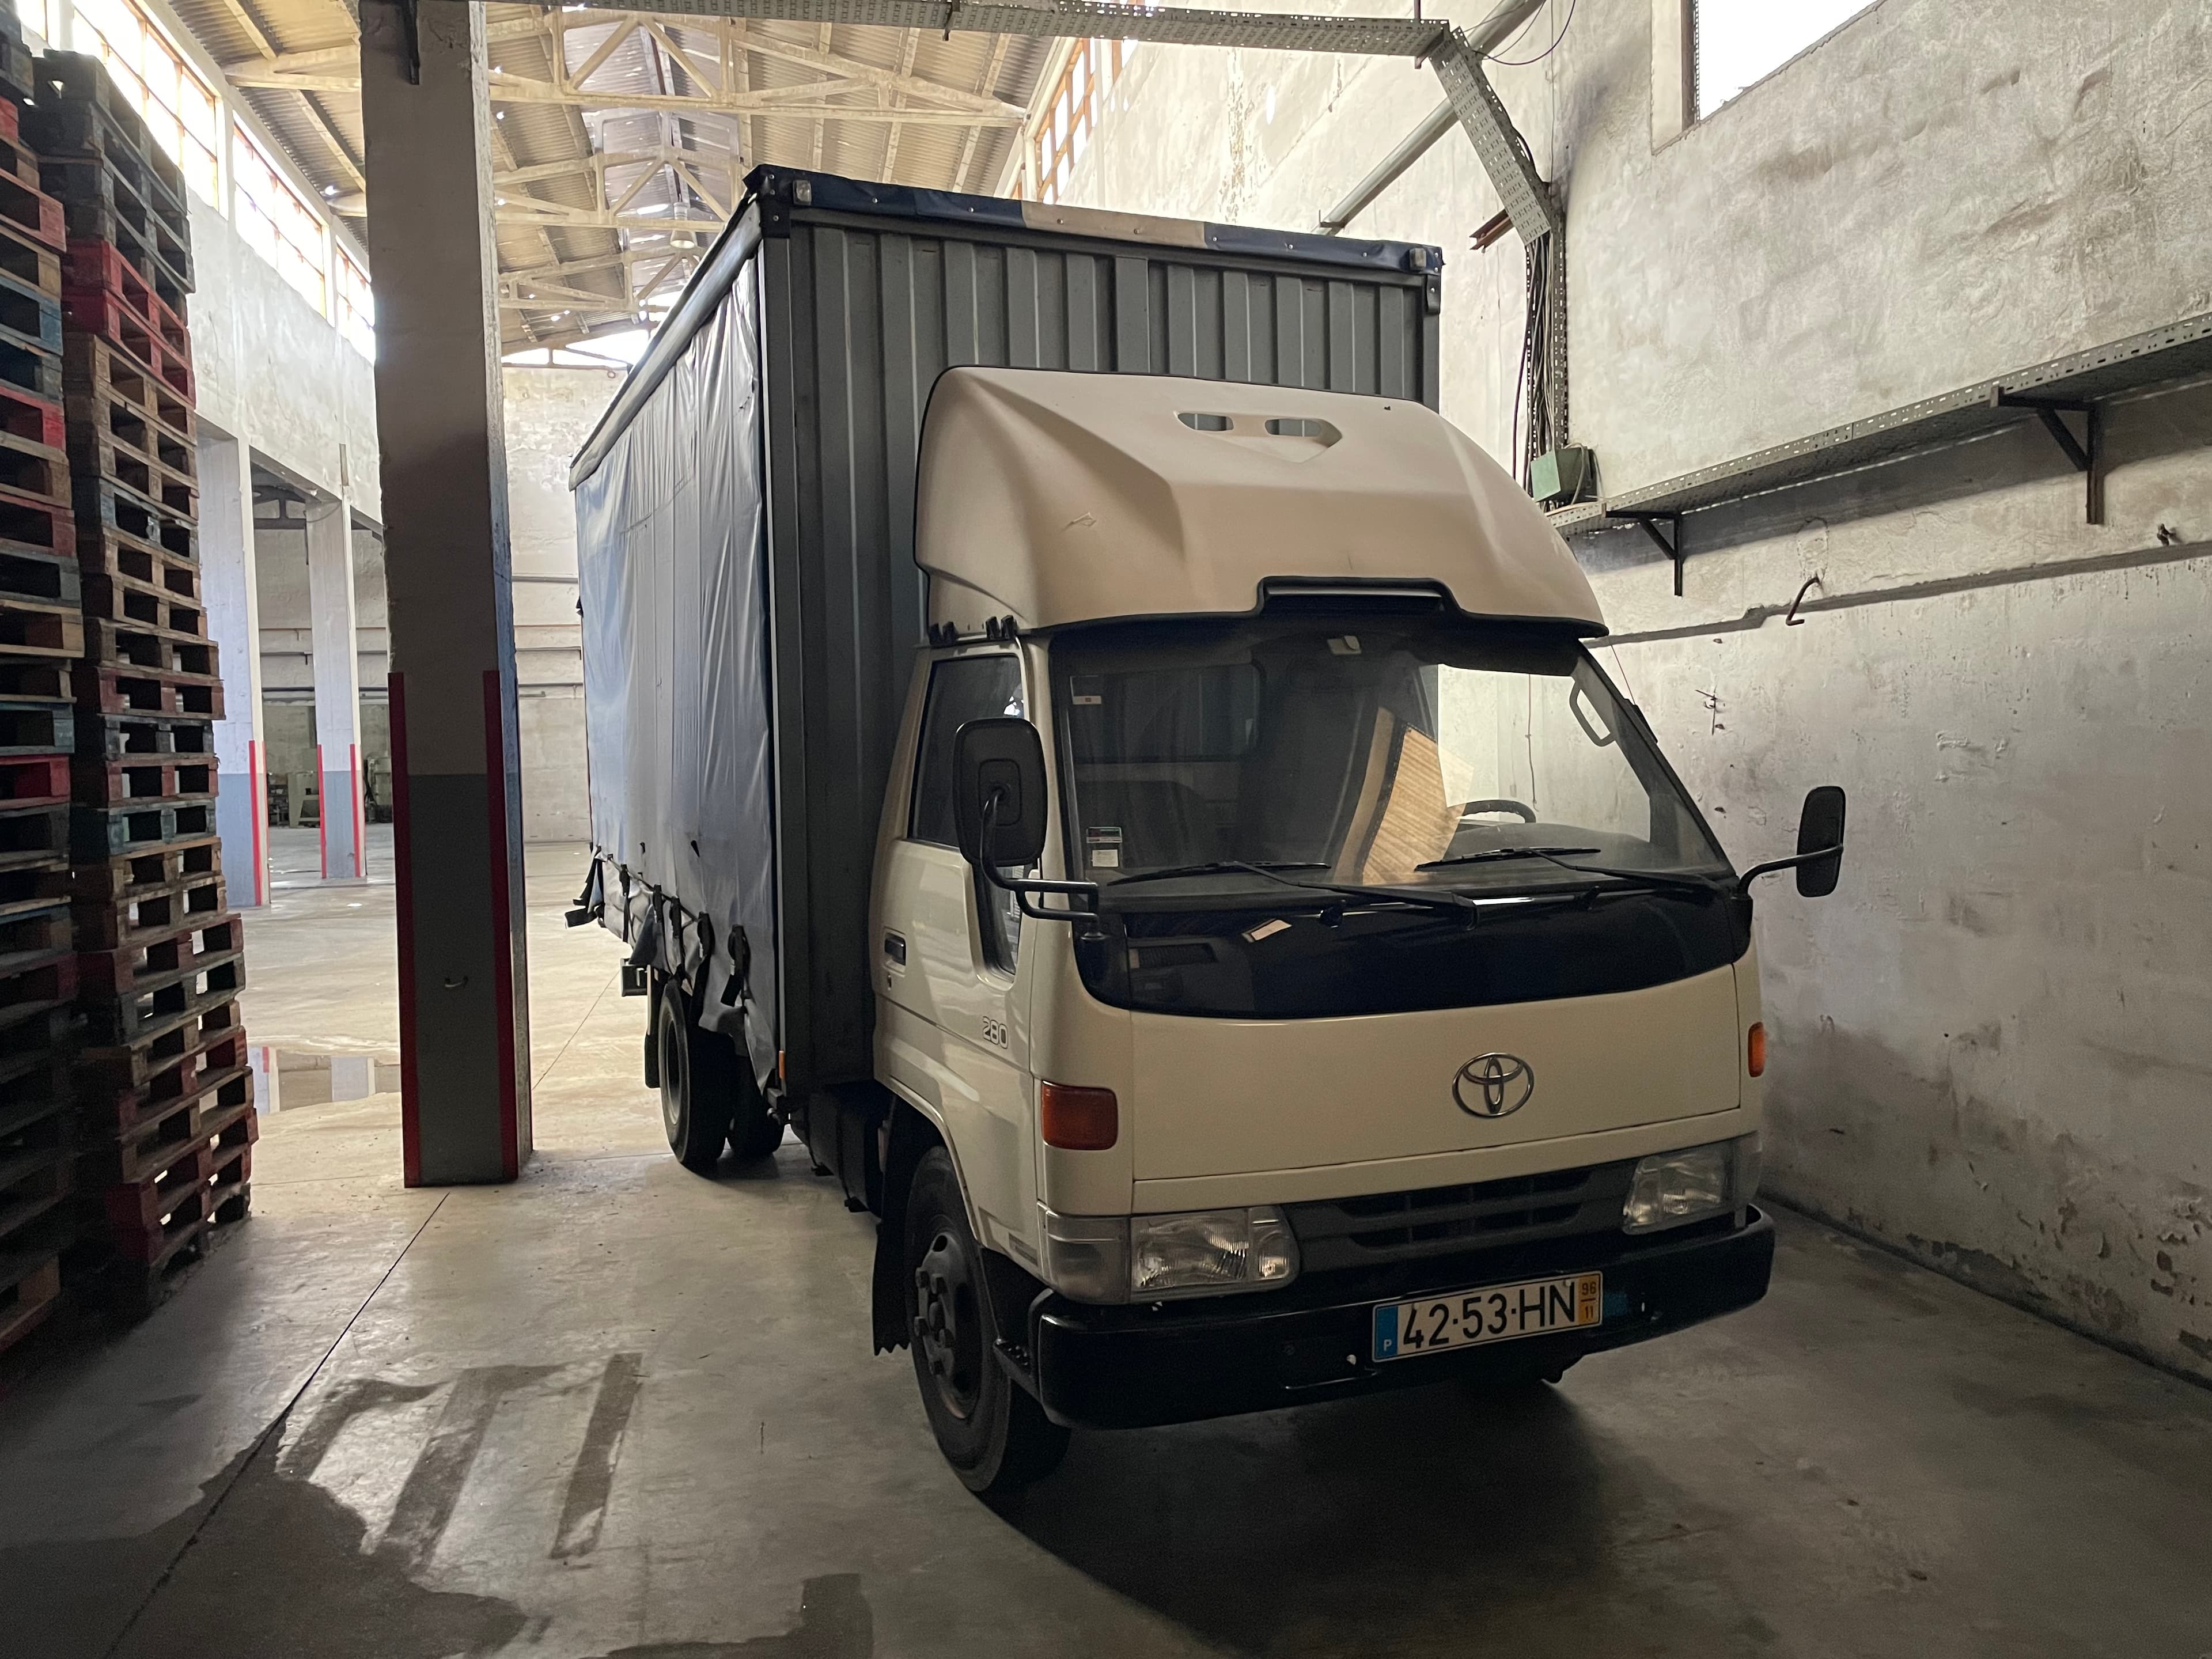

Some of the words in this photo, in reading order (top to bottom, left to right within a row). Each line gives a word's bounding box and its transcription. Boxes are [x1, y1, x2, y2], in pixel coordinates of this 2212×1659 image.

[983, 1016, 1008, 1050] 280
[1582, 1281, 1597, 1295] 96
[1585, 1305, 1594, 1319] 11
[1384, 1339, 1392, 1351] P
